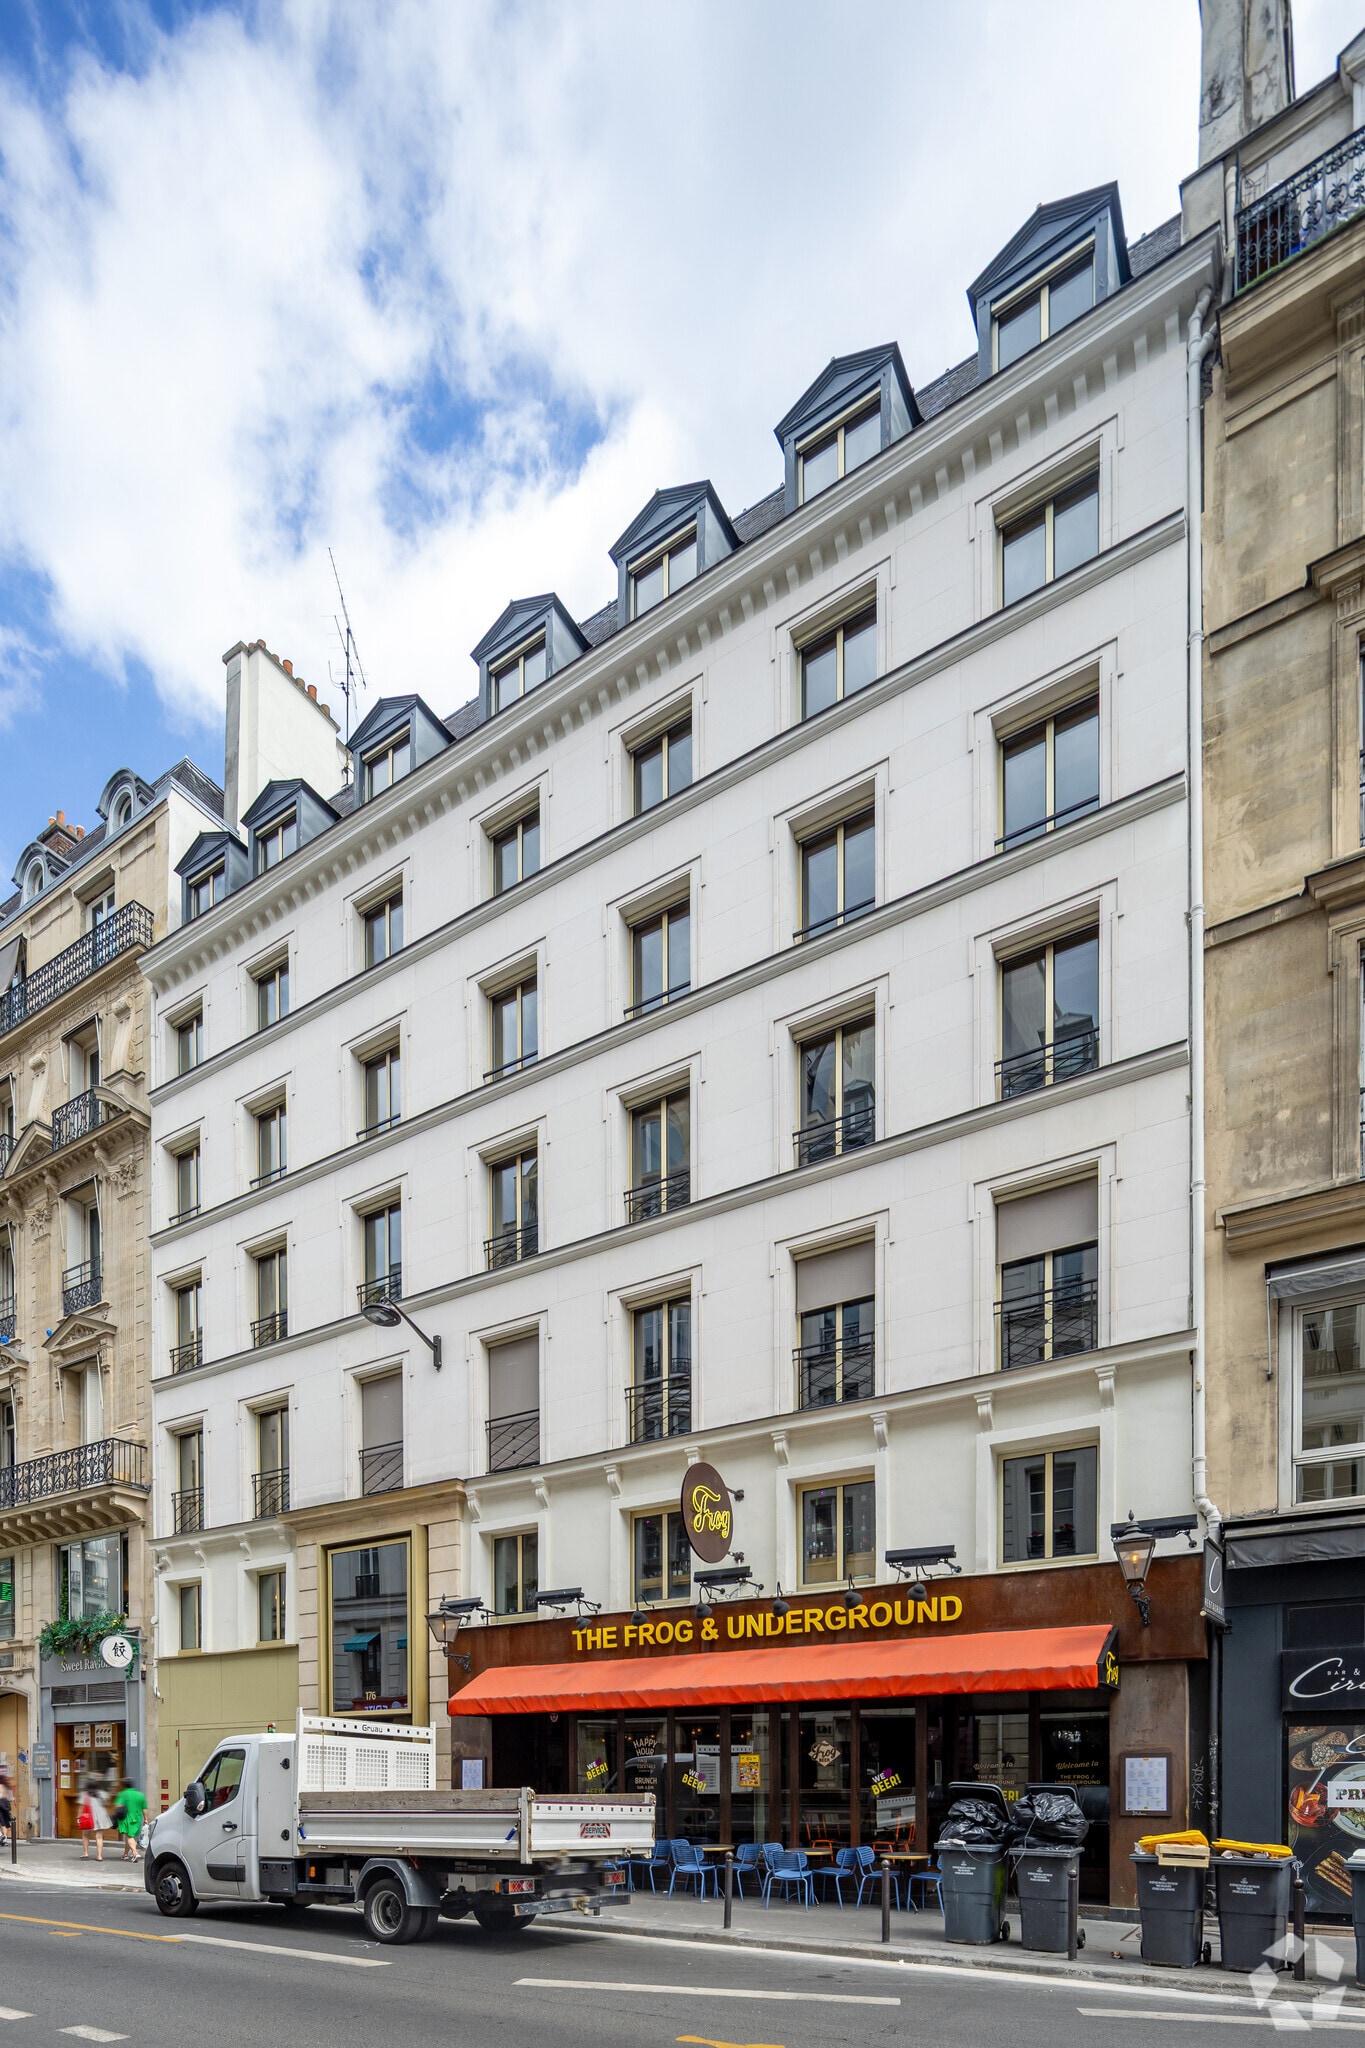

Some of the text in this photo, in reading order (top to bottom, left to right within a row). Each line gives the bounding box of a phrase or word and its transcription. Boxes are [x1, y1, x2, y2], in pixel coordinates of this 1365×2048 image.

[692, 1485, 731, 1539] Frog
[571, 1595, 963, 1651] THE FROG & UNDERGROUND
[61, 1661, 83, 1672] Sweet
[1105, 1650, 1119, 1686] Frog
[365, 1691, 377, 1700] 176
[361, 1724, 383, 1733] Gruau
[633, 1739, 658, 1748] HAPPY
[636, 1747, 655, 1756] HOUR
[810, 1741, 838, 1762] Frog
[586, 1760, 597, 1770] WE
[1056, 1761, 1090, 1770] Welcome
[585, 1762, 609, 1780] BEER!
[688, 1769, 699, 1777] WE
[634, 1777, 658, 1785] BRUNCH
[681, 1773, 707, 1792] BEER!
[872, 1772, 885, 1784] WE
[871, 1773, 902, 1796] BEER!
